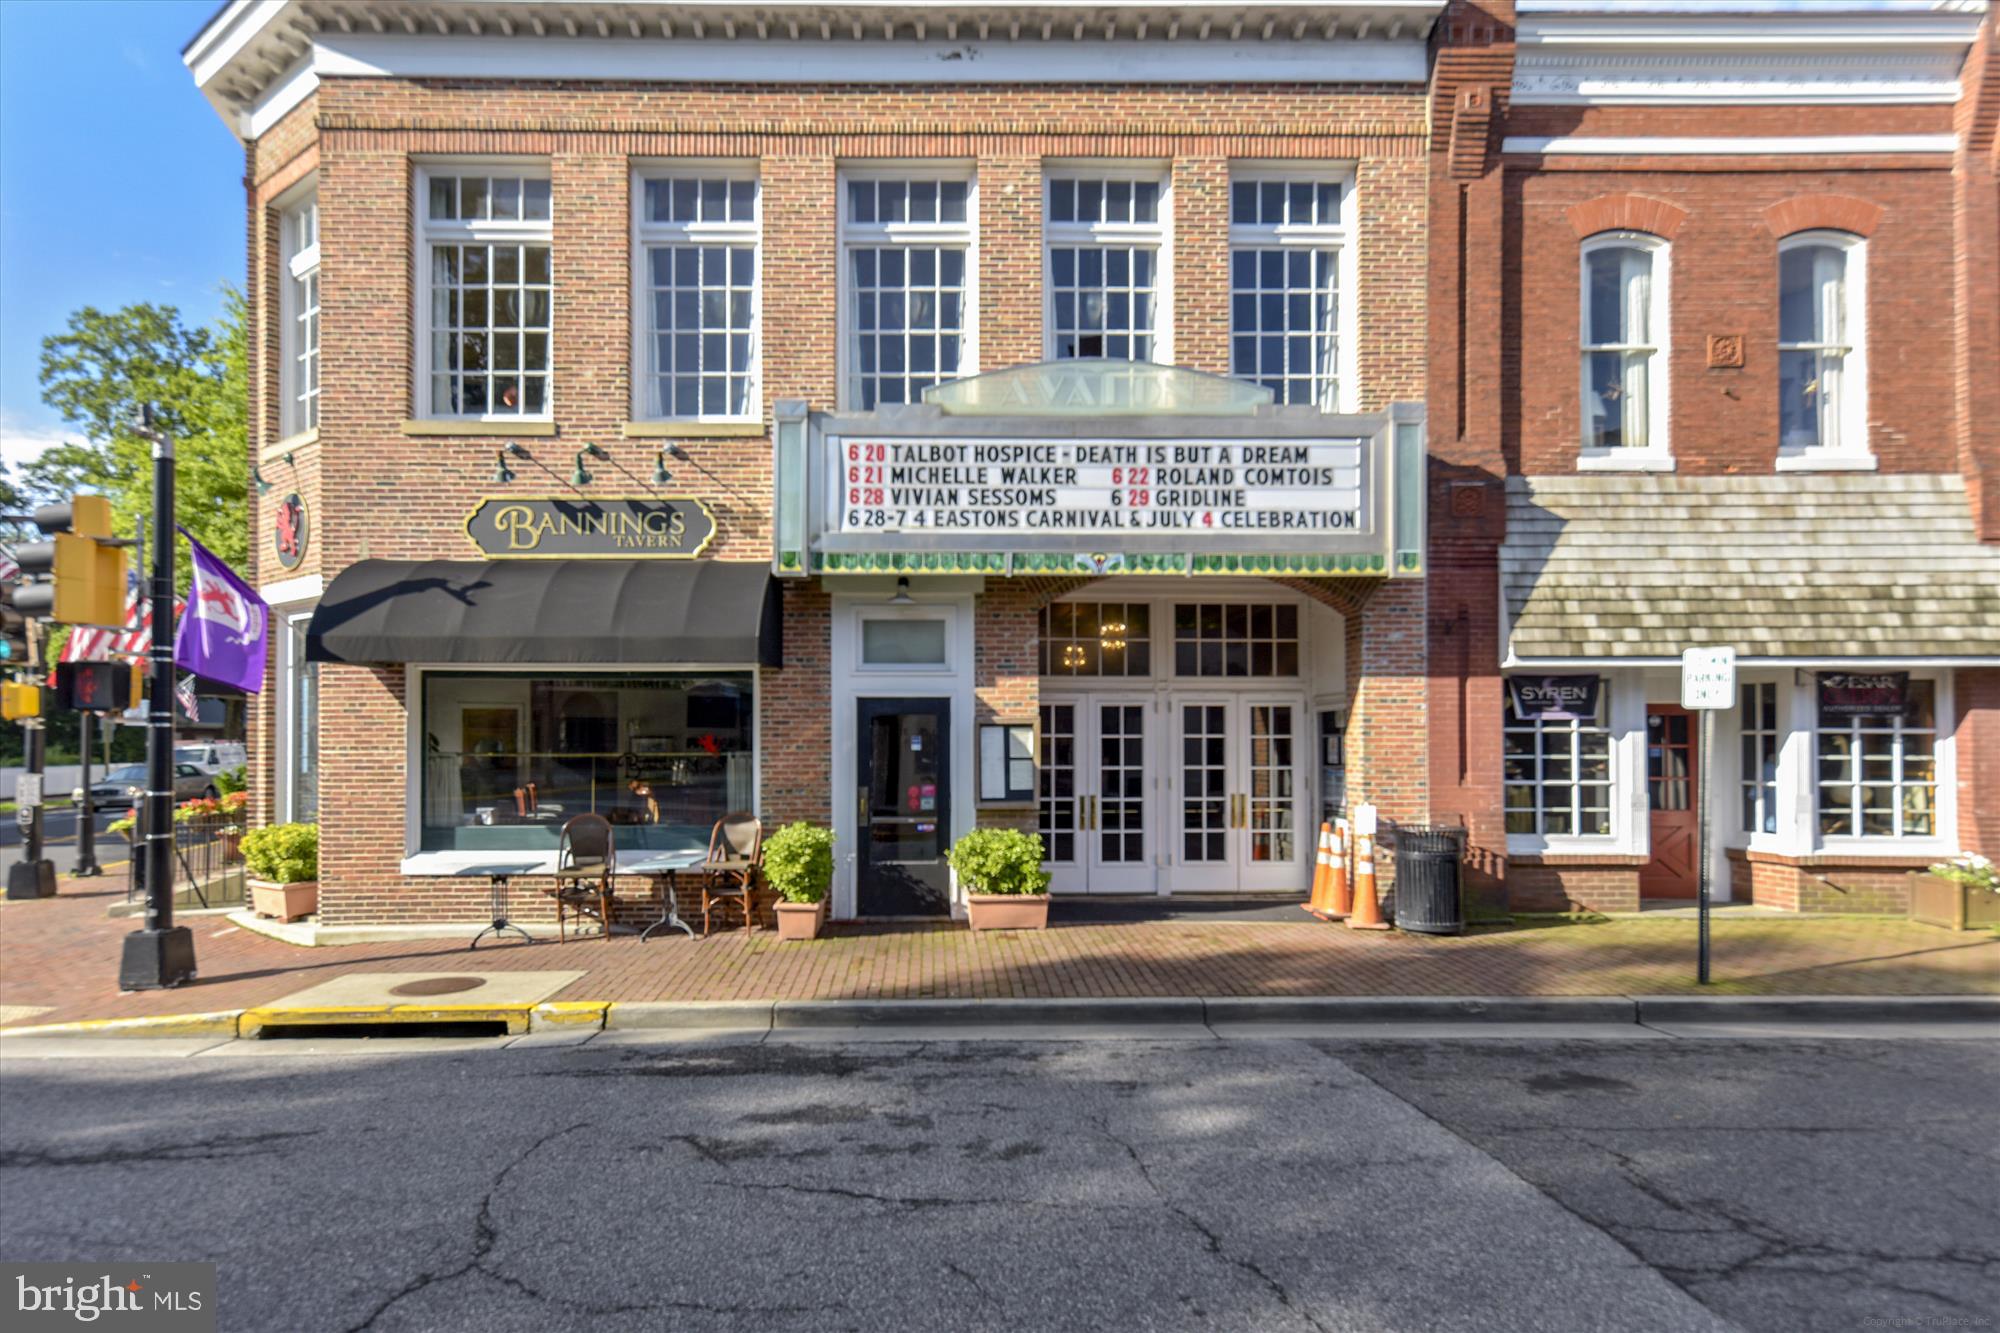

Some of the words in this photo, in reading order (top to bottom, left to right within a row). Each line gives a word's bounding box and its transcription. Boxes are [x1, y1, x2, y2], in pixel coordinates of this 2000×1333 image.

[848, 444, 859, 462] 6
[865, 444, 885, 462] 20
[891, 445, 965, 463] TALBOT
[974, 445, 1056, 463] HOSPICE
[1076, 445, 1137, 463] DEATH
[1146, 446, 1165, 464] IS
[1174, 446, 1212, 464] BUT
[1219, 447, 1232, 464] A
[1242, 446, 1309, 464] DREAM
[849, 467, 859, 483] 6
[864, 467, 883, 483] 21
[891, 467, 988, 484] MICHELLE
[1001, 467, 1078, 484] WALKER
[1112, 468, 1122, 485] 6
[1128, 468, 1149, 485] 22
[1156, 468, 1234, 485] ROLAND
[1244, 468, 1333, 485] COMTOIS
[849, 489, 859, 505] 6
[864, 489, 884, 505] 28
[891, 489, 958, 505] VIVIAN
[968, 489, 1057, 505] SESSOMS
[1111, 490, 1121, 506] 6
[1128, 490, 1149, 506] 29
[1156, 490, 1246, 506] GRIDLINE
[849, 510, 859, 526] 6
[914, 511, 926, 527] 4
[934, 511, 1019, 527] EASTONS
[1026, 511, 1124, 527] CARNIVAL
[1146, 511, 1195, 528] JULY
[1201, 512, 1213, 528] 4
[1221, 511, 1355, 528] CELEBRATION
[613, 535, 683, 548] TAVERN
[1521, 686, 1588, 700] SYREN
